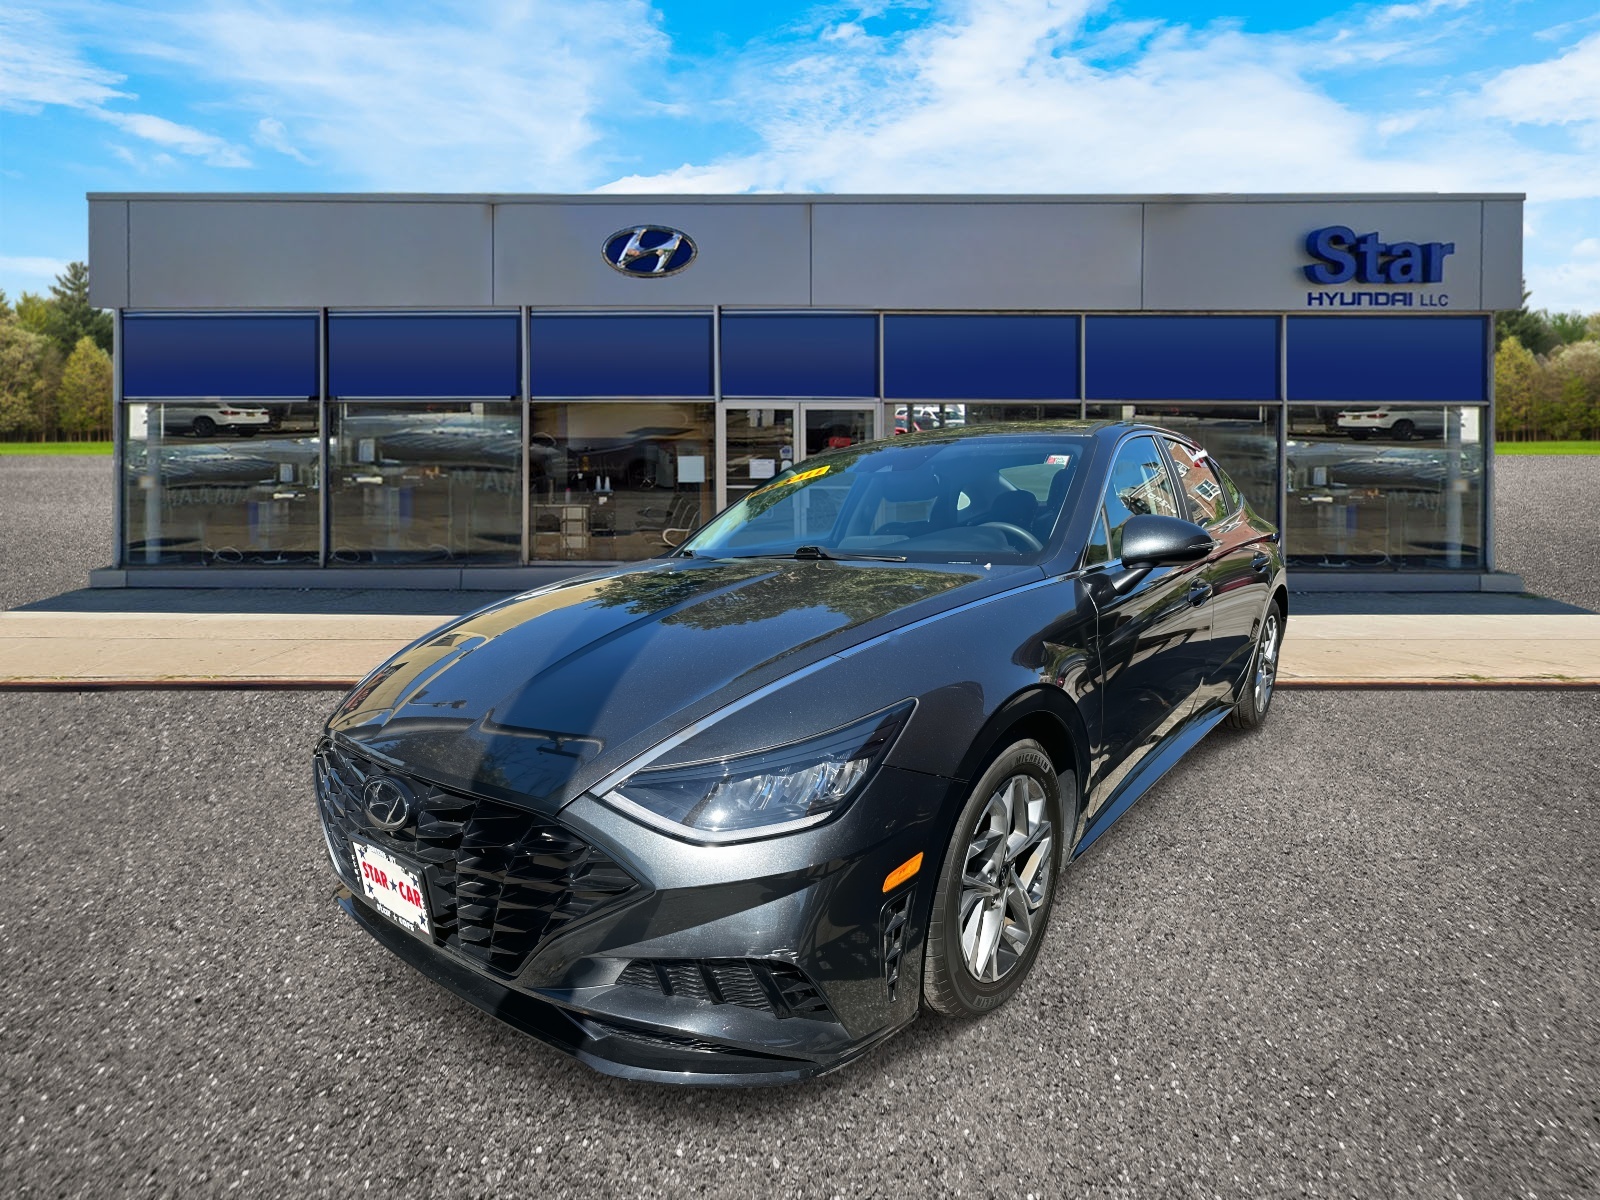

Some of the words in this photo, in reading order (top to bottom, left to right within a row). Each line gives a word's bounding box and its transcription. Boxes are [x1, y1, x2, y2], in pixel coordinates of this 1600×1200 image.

[1303, 225, 1454, 284] Star
[1307, 292, 1413, 306] HYUNDAI
[1420, 294, 1449, 306] LLC
[1015, 752, 1049, 772] MICHELIN
[362, 861, 390, 891] STAR
[398, 881, 423, 910] CAR
